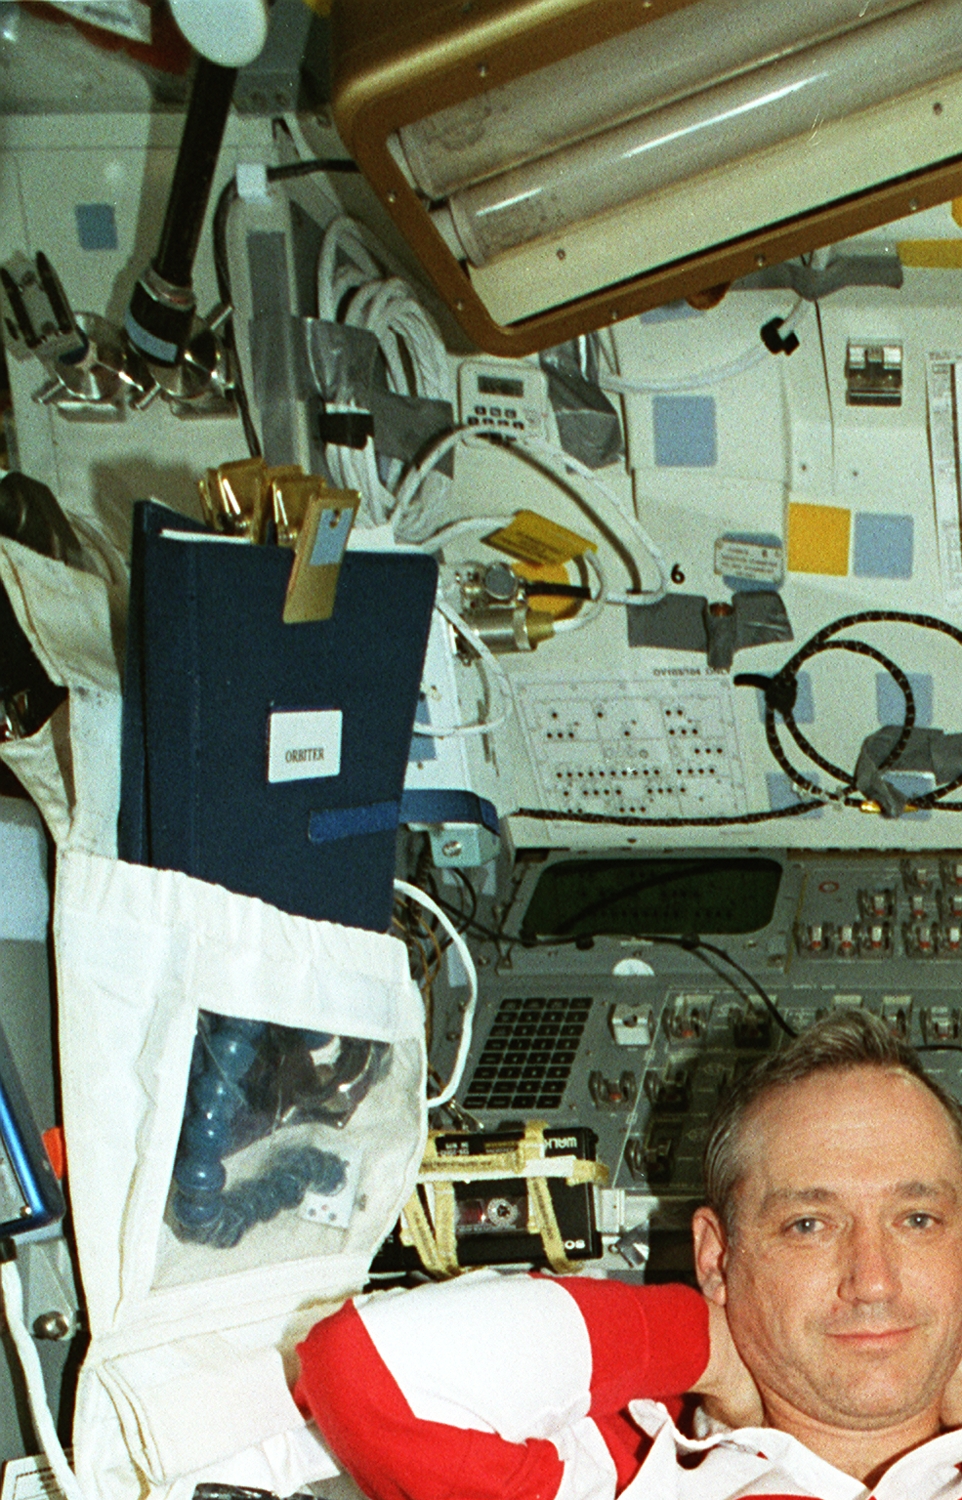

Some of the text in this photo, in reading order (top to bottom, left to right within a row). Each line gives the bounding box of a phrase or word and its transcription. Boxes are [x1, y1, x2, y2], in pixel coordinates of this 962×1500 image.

[671, 563, 686, 585] 6
[285, 746, 325, 764] ORBITER
[564, 1239, 586, 1250] SO
